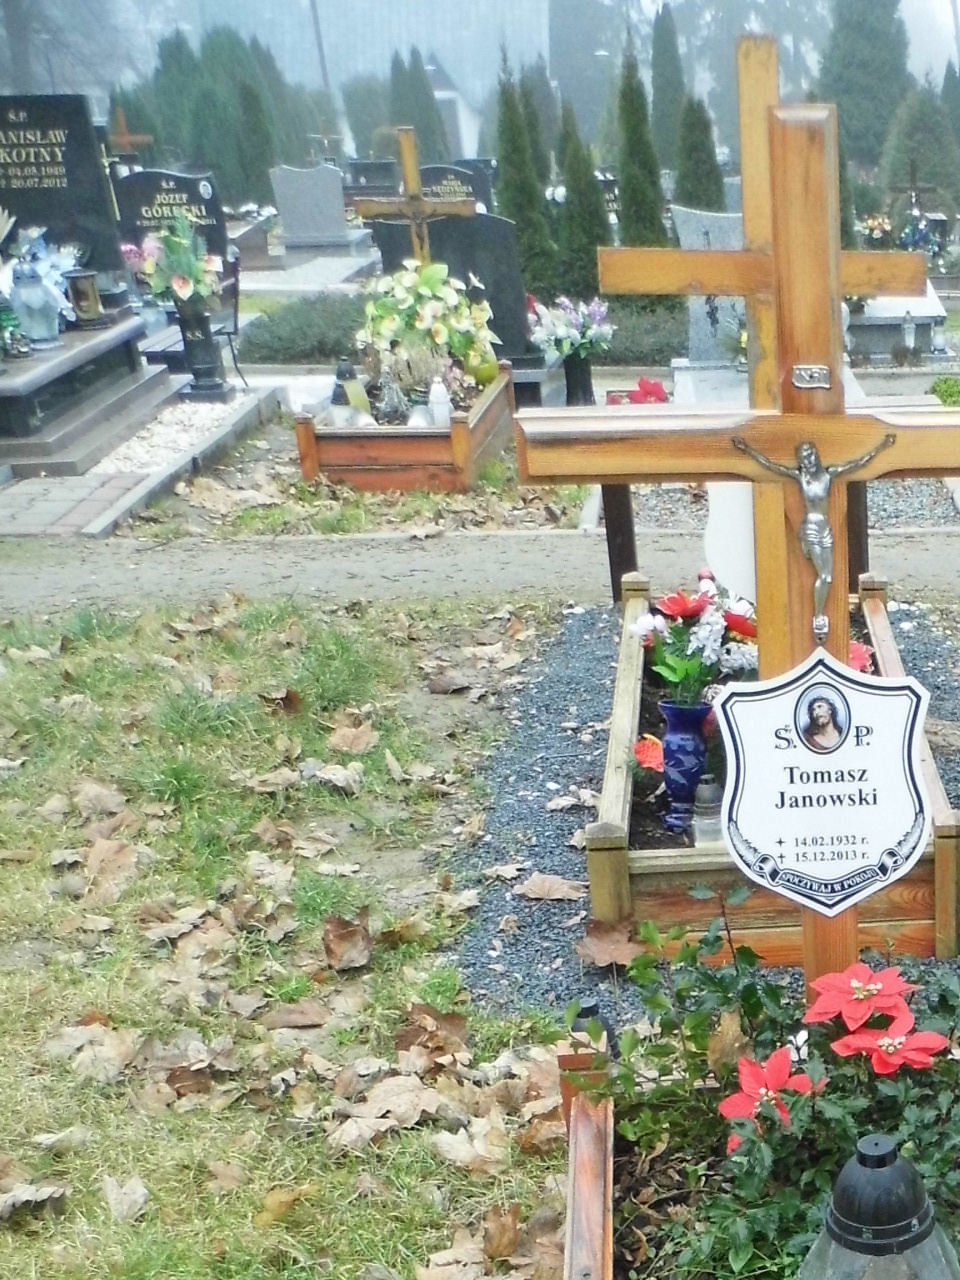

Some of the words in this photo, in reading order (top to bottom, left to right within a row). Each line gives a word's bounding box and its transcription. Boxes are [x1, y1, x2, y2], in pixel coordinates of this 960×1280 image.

[783, 766, 869, 785] Tomasz
[774, 788, 878, 810] Janowski
[794, 835, 857, 848] 14.02.1932
[795, 850, 857, 862] 15.12.2013
[781, 870, 832, 894] SPOCZYWAJ
[832, 883, 843, 892] W
[842, 868, 879, 889] POKOJU
